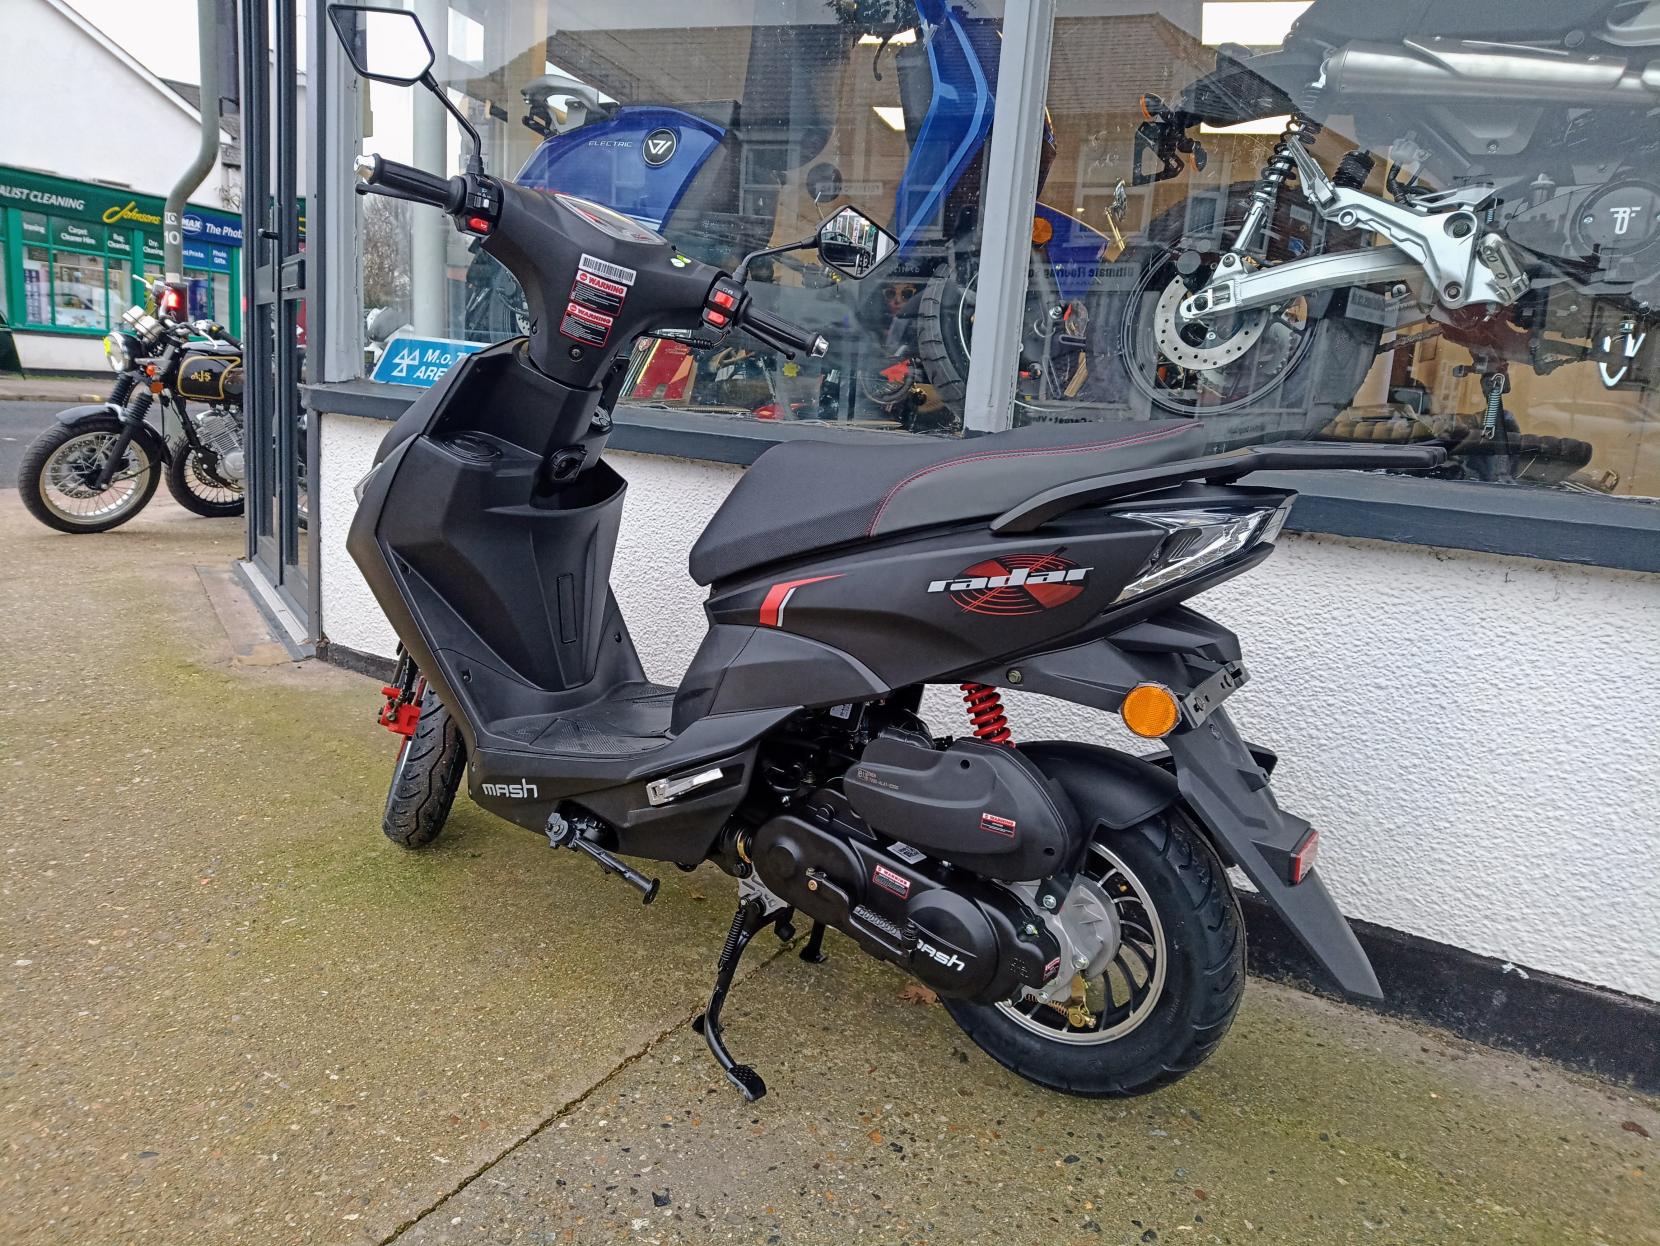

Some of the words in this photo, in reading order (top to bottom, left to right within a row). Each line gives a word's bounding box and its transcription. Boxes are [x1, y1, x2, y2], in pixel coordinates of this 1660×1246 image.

[588, 140, 633, 148] ELECTRIC
[29, 191, 85, 211] CLEANING
[103, 201, 161, 224] Johnsons
[164, 231, 180, 245] 10
[206, 222, 222, 235] The
[222, 226, 243, 239] Phot
[588, 276, 625, 295] WARNING
[577, 308, 612, 324] WARNING
[927, 567, 1094, 593] radar
